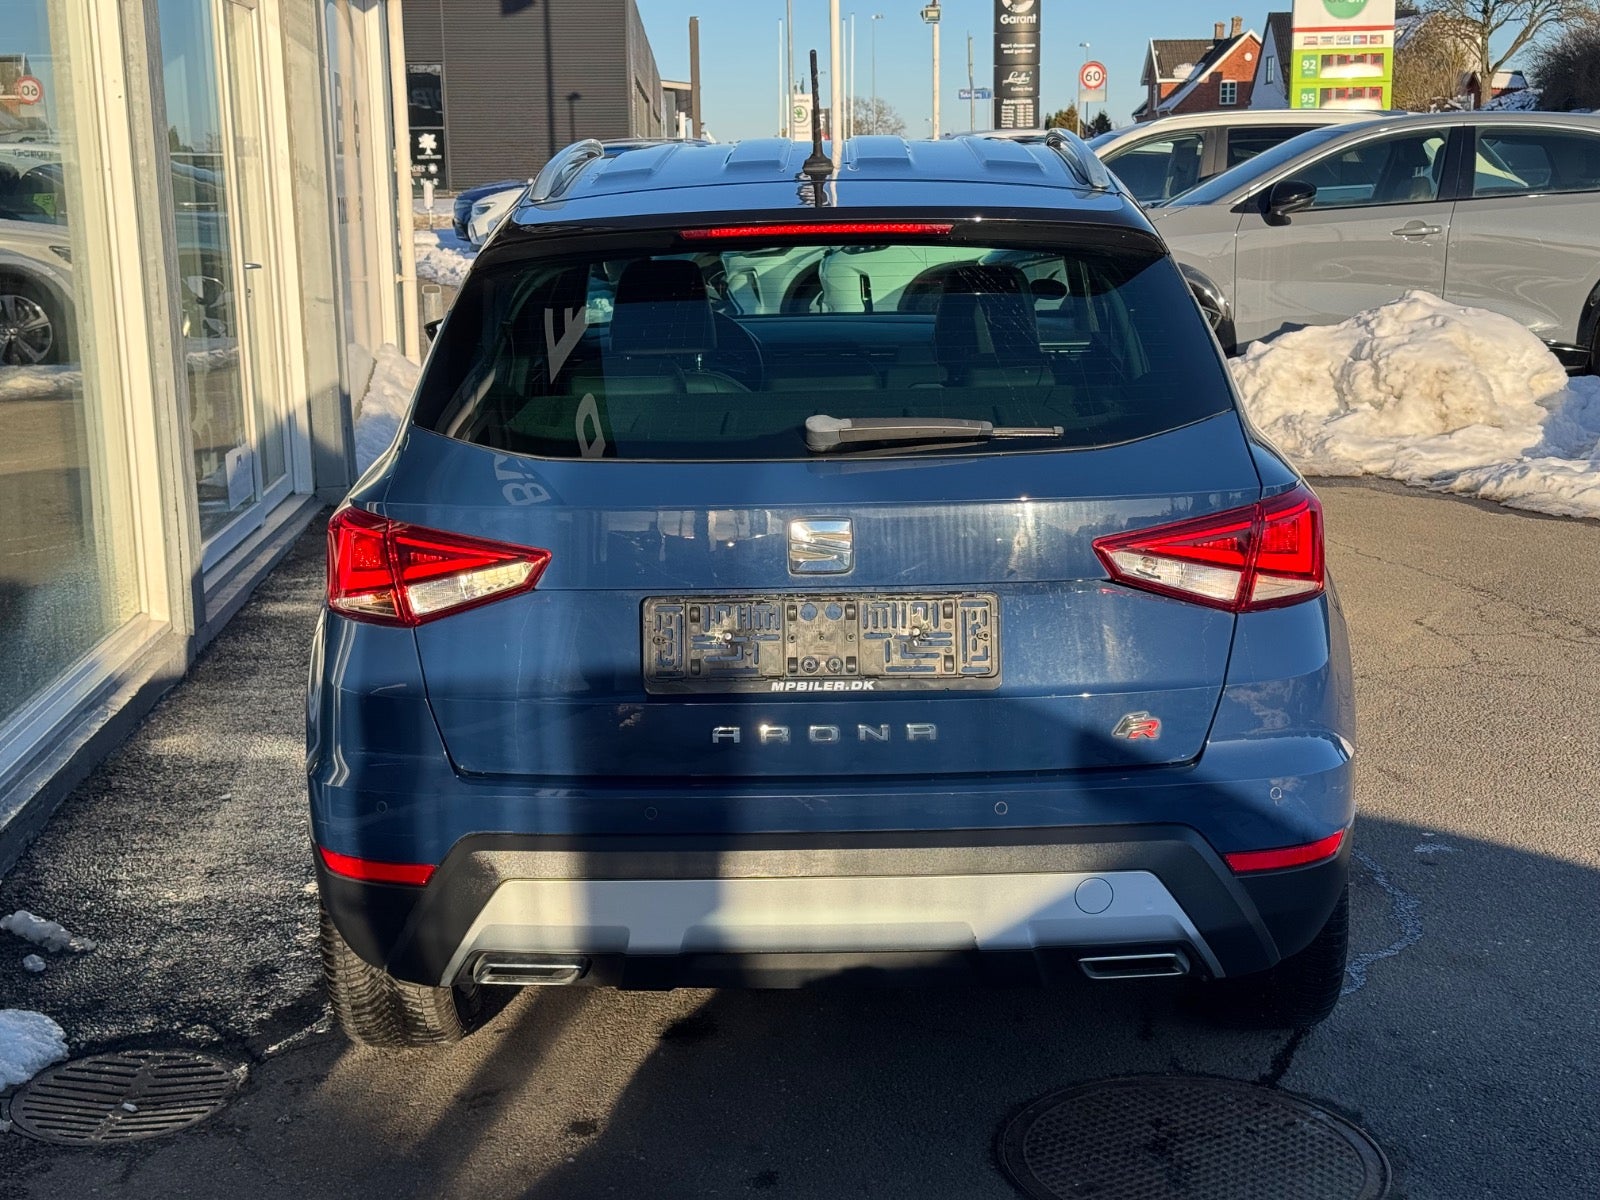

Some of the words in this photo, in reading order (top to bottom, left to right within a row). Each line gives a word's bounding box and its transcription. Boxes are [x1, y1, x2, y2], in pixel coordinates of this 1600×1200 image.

[1000, 13, 1037, 25] Garant
[1302, 60, 1316, 70] 92
[1085, 71, 1100, 82] 60
[1301, 93, 1315, 103] 95
[770, 680, 875, 692] MPBILER.DK
[1112, 711, 1161, 740] FR
[711, 722, 938, 744] ARONA
